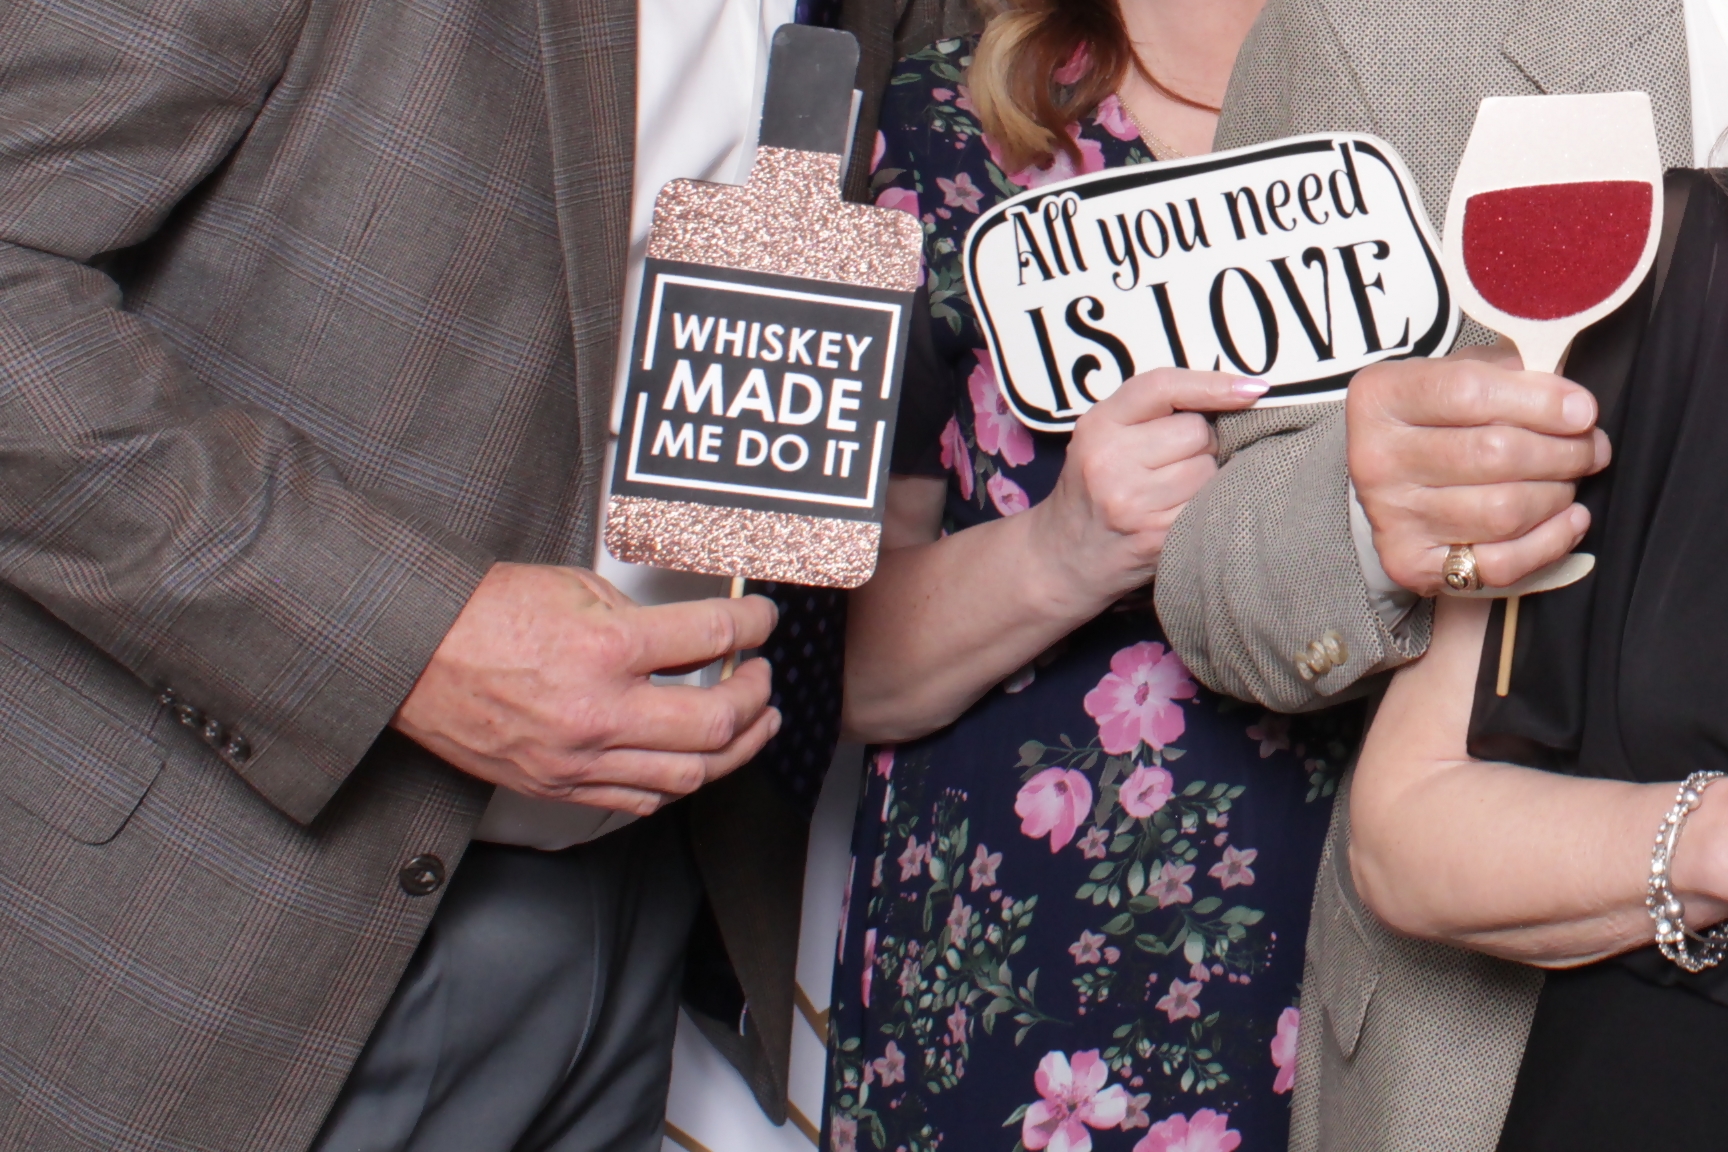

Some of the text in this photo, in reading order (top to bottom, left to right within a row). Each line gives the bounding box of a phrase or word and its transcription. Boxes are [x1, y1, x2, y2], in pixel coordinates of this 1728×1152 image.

[1011, 141, 1370, 291] All you need
[672, 312, 873, 371] WHISKEY
[1025, 239, 1411, 413] IS LOVE
[662, 358, 863, 432] MADE
[651, 419, 861, 478] ME DO IT
